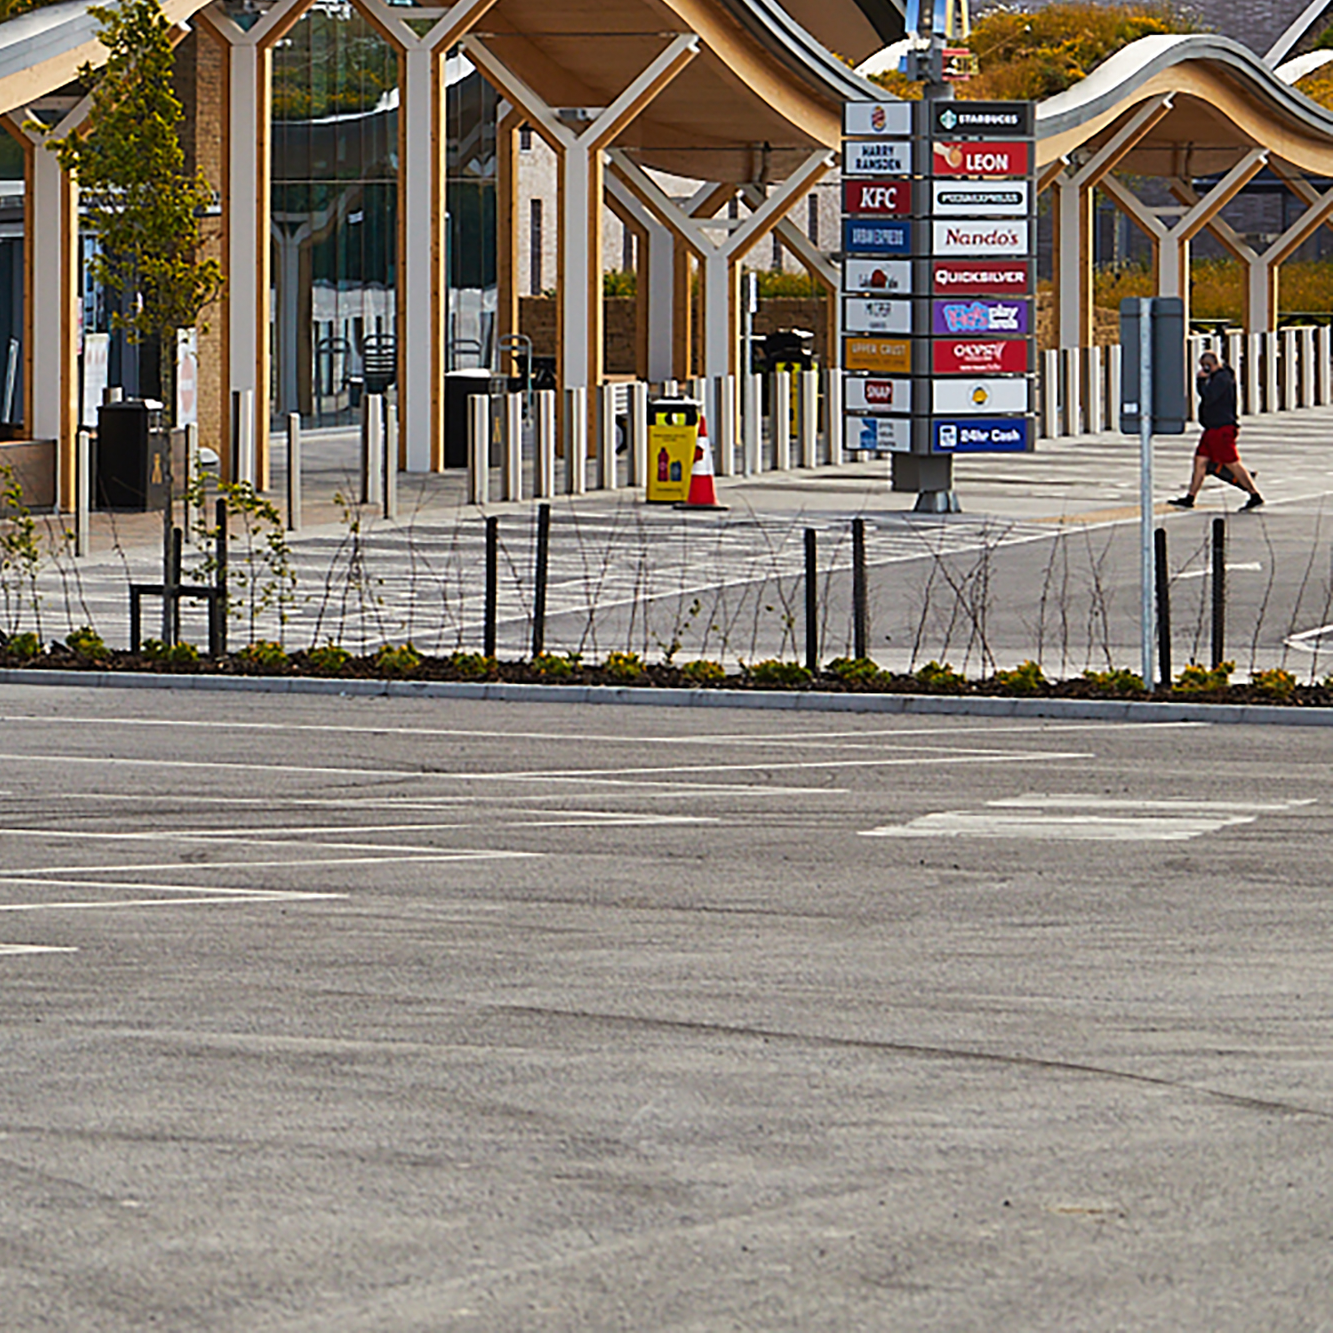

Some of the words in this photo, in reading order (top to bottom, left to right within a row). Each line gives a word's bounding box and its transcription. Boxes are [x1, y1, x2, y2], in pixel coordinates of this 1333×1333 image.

[958, 114, 1019, 125] STARBUCKS
[965, 153, 1009, 172] LEON
[859, 187, 898, 209] KFC
[945, 228, 1019, 246] Nando's
